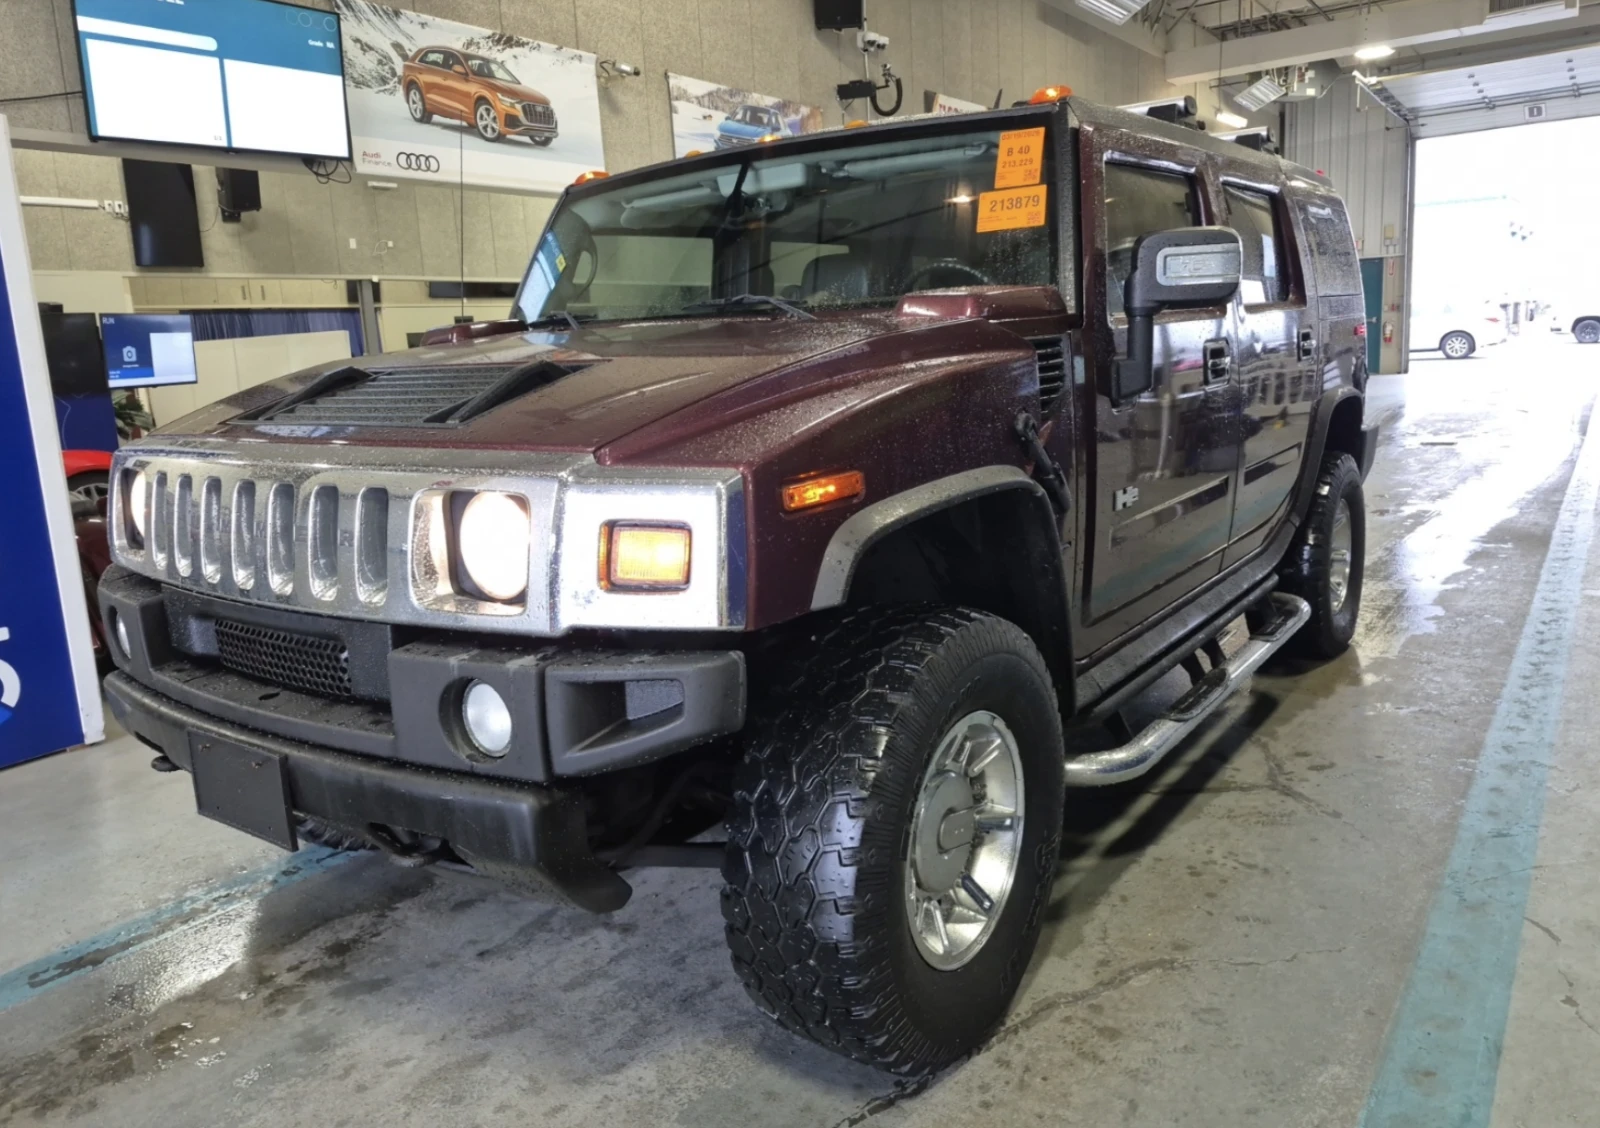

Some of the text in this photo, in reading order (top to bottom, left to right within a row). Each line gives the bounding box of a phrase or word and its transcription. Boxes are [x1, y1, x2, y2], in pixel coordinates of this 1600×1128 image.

[362, 151, 382, 159] Audi
[1007, 145, 1030, 157] B 40
[362, 158, 392, 168] Finance
[989, 195, 1040, 213] 213879
